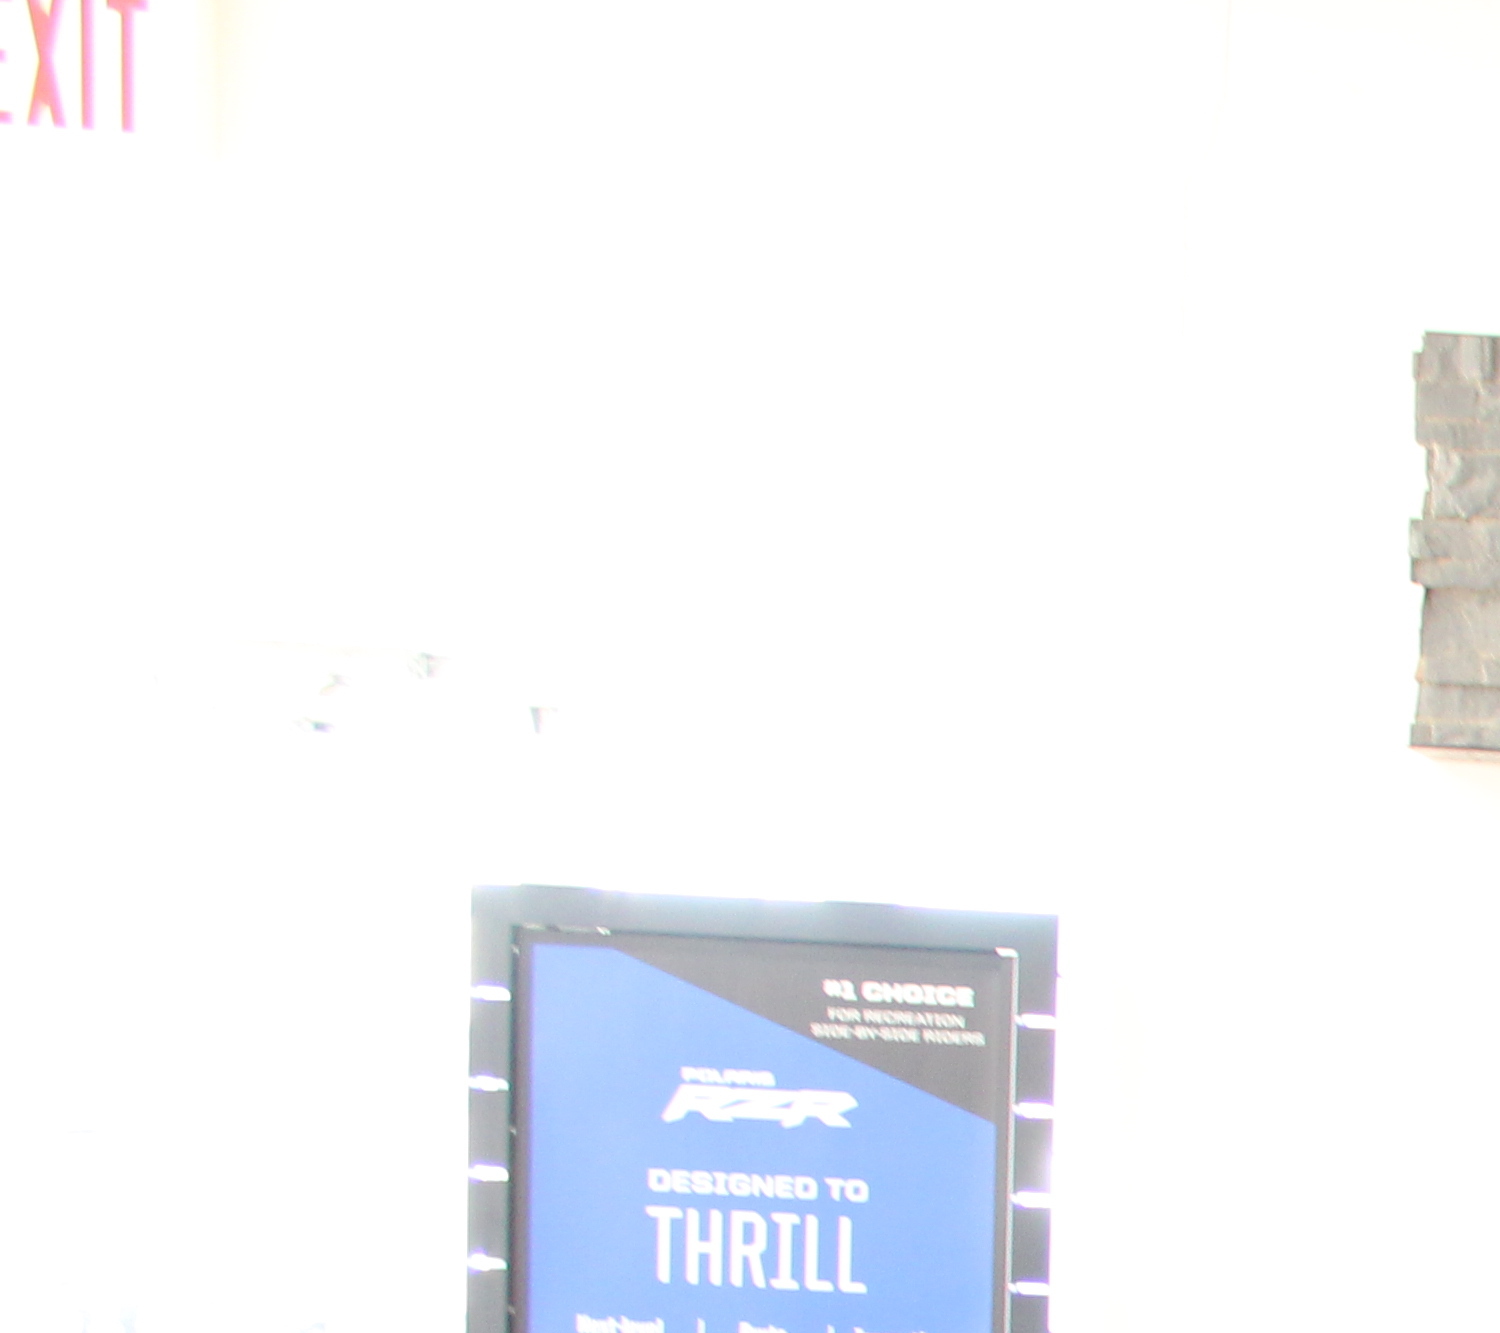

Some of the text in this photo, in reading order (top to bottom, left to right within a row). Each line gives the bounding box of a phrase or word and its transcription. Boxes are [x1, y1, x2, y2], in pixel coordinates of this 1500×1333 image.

[0, 0, 149, 133] XIT
[860, 980, 976, 1008] CHOICE
[647, 1168, 870, 1203] DESIGNED TO
[645, 1204, 867, 1295] THRILL
